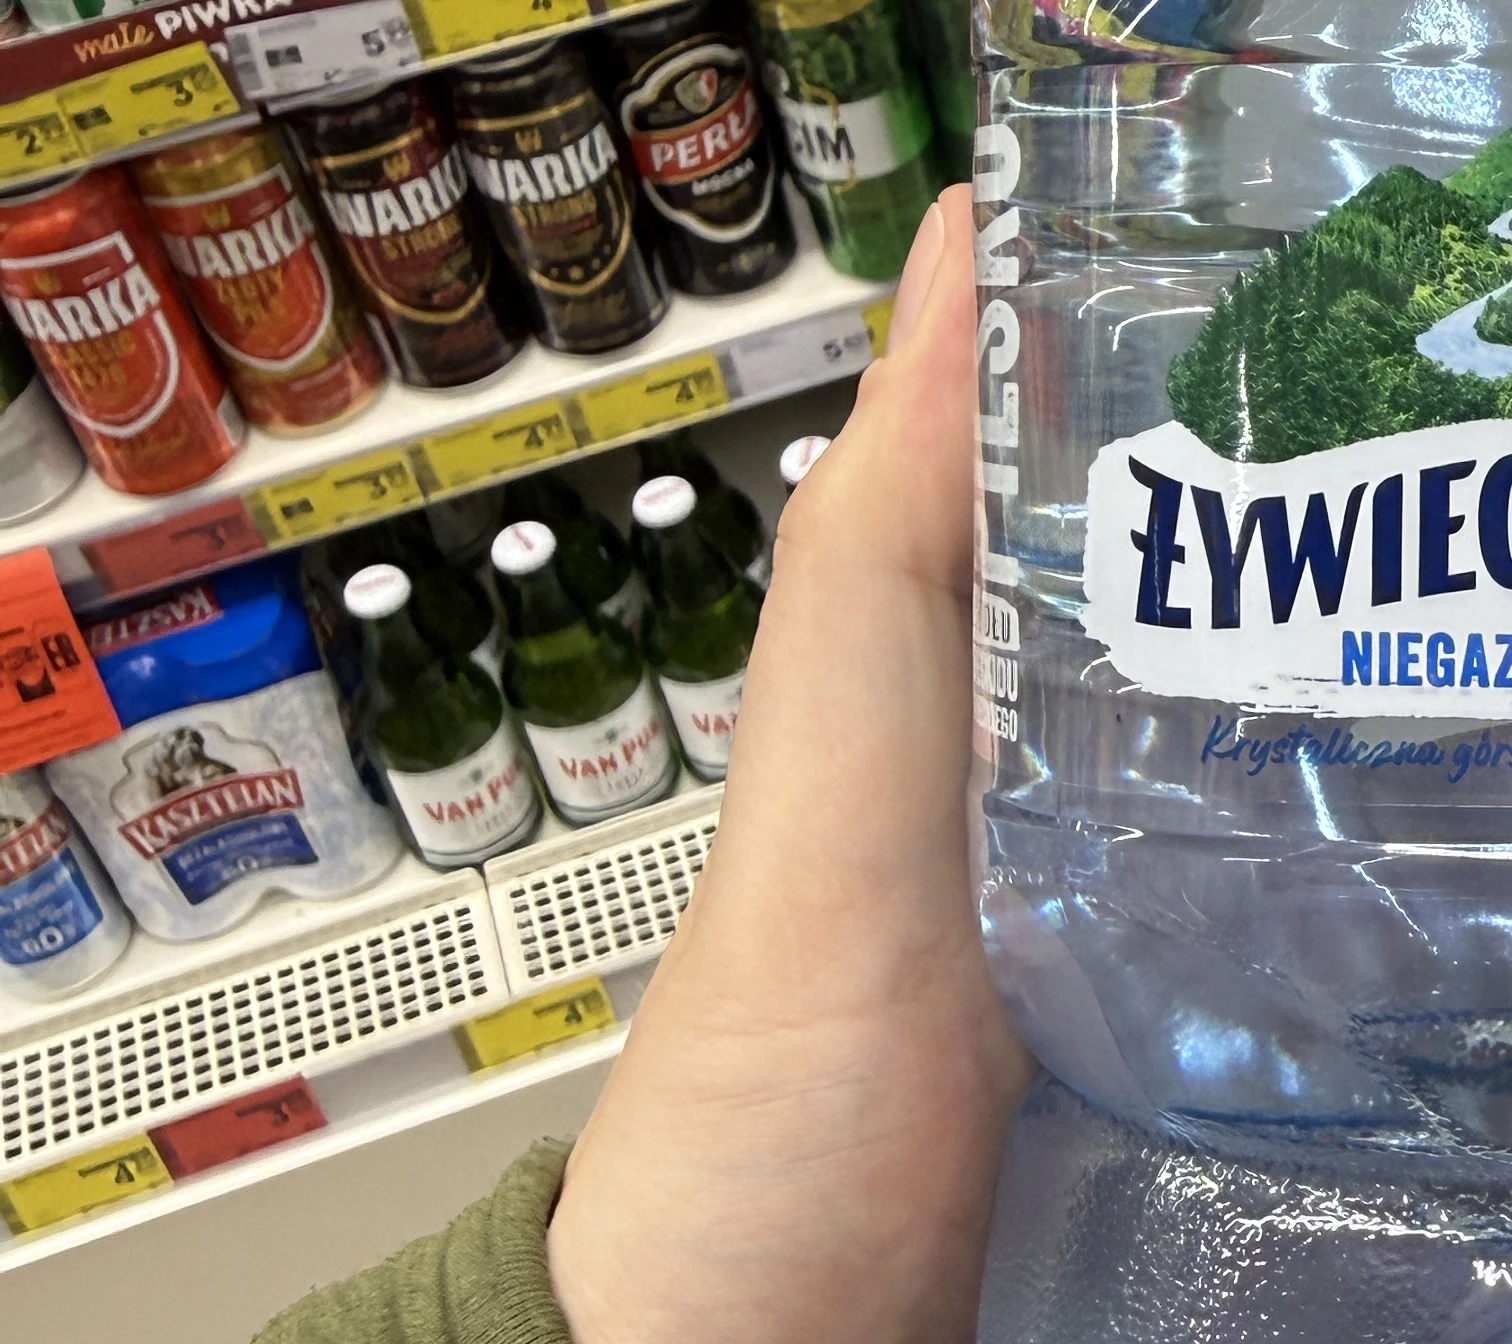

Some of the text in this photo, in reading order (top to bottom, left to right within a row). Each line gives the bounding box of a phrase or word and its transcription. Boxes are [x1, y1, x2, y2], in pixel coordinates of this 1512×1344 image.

[1200, 715, 1447, 776] Krystaliczna
[558, 754, 619, 781] VAN
[422, 791, 486, 826] VAN
